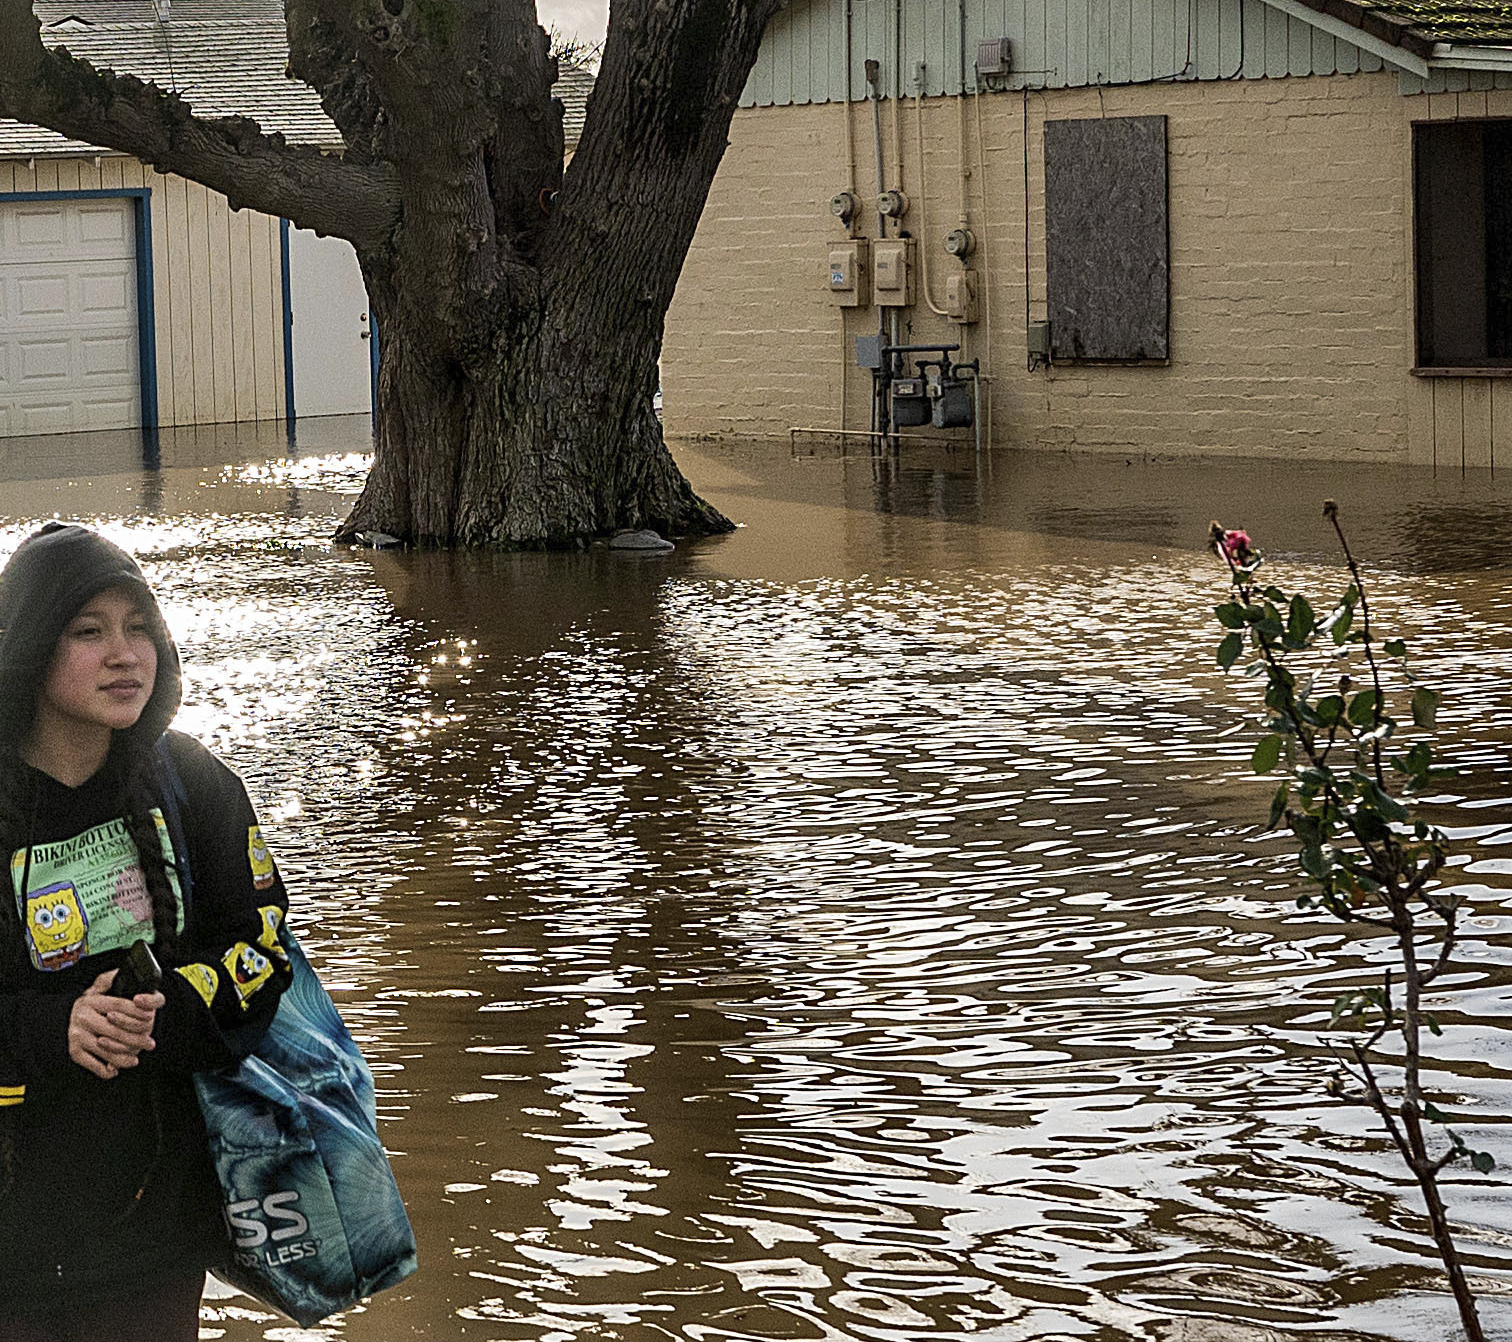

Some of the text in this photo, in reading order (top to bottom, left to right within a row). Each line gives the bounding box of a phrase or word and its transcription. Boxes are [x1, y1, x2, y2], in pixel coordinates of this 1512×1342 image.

[34, 821, 126, 865] BIKINI BOTTO
[53, 837, 128, 868] DRIVER LICENSE
[265, 1241, 317, 1267] LESS
